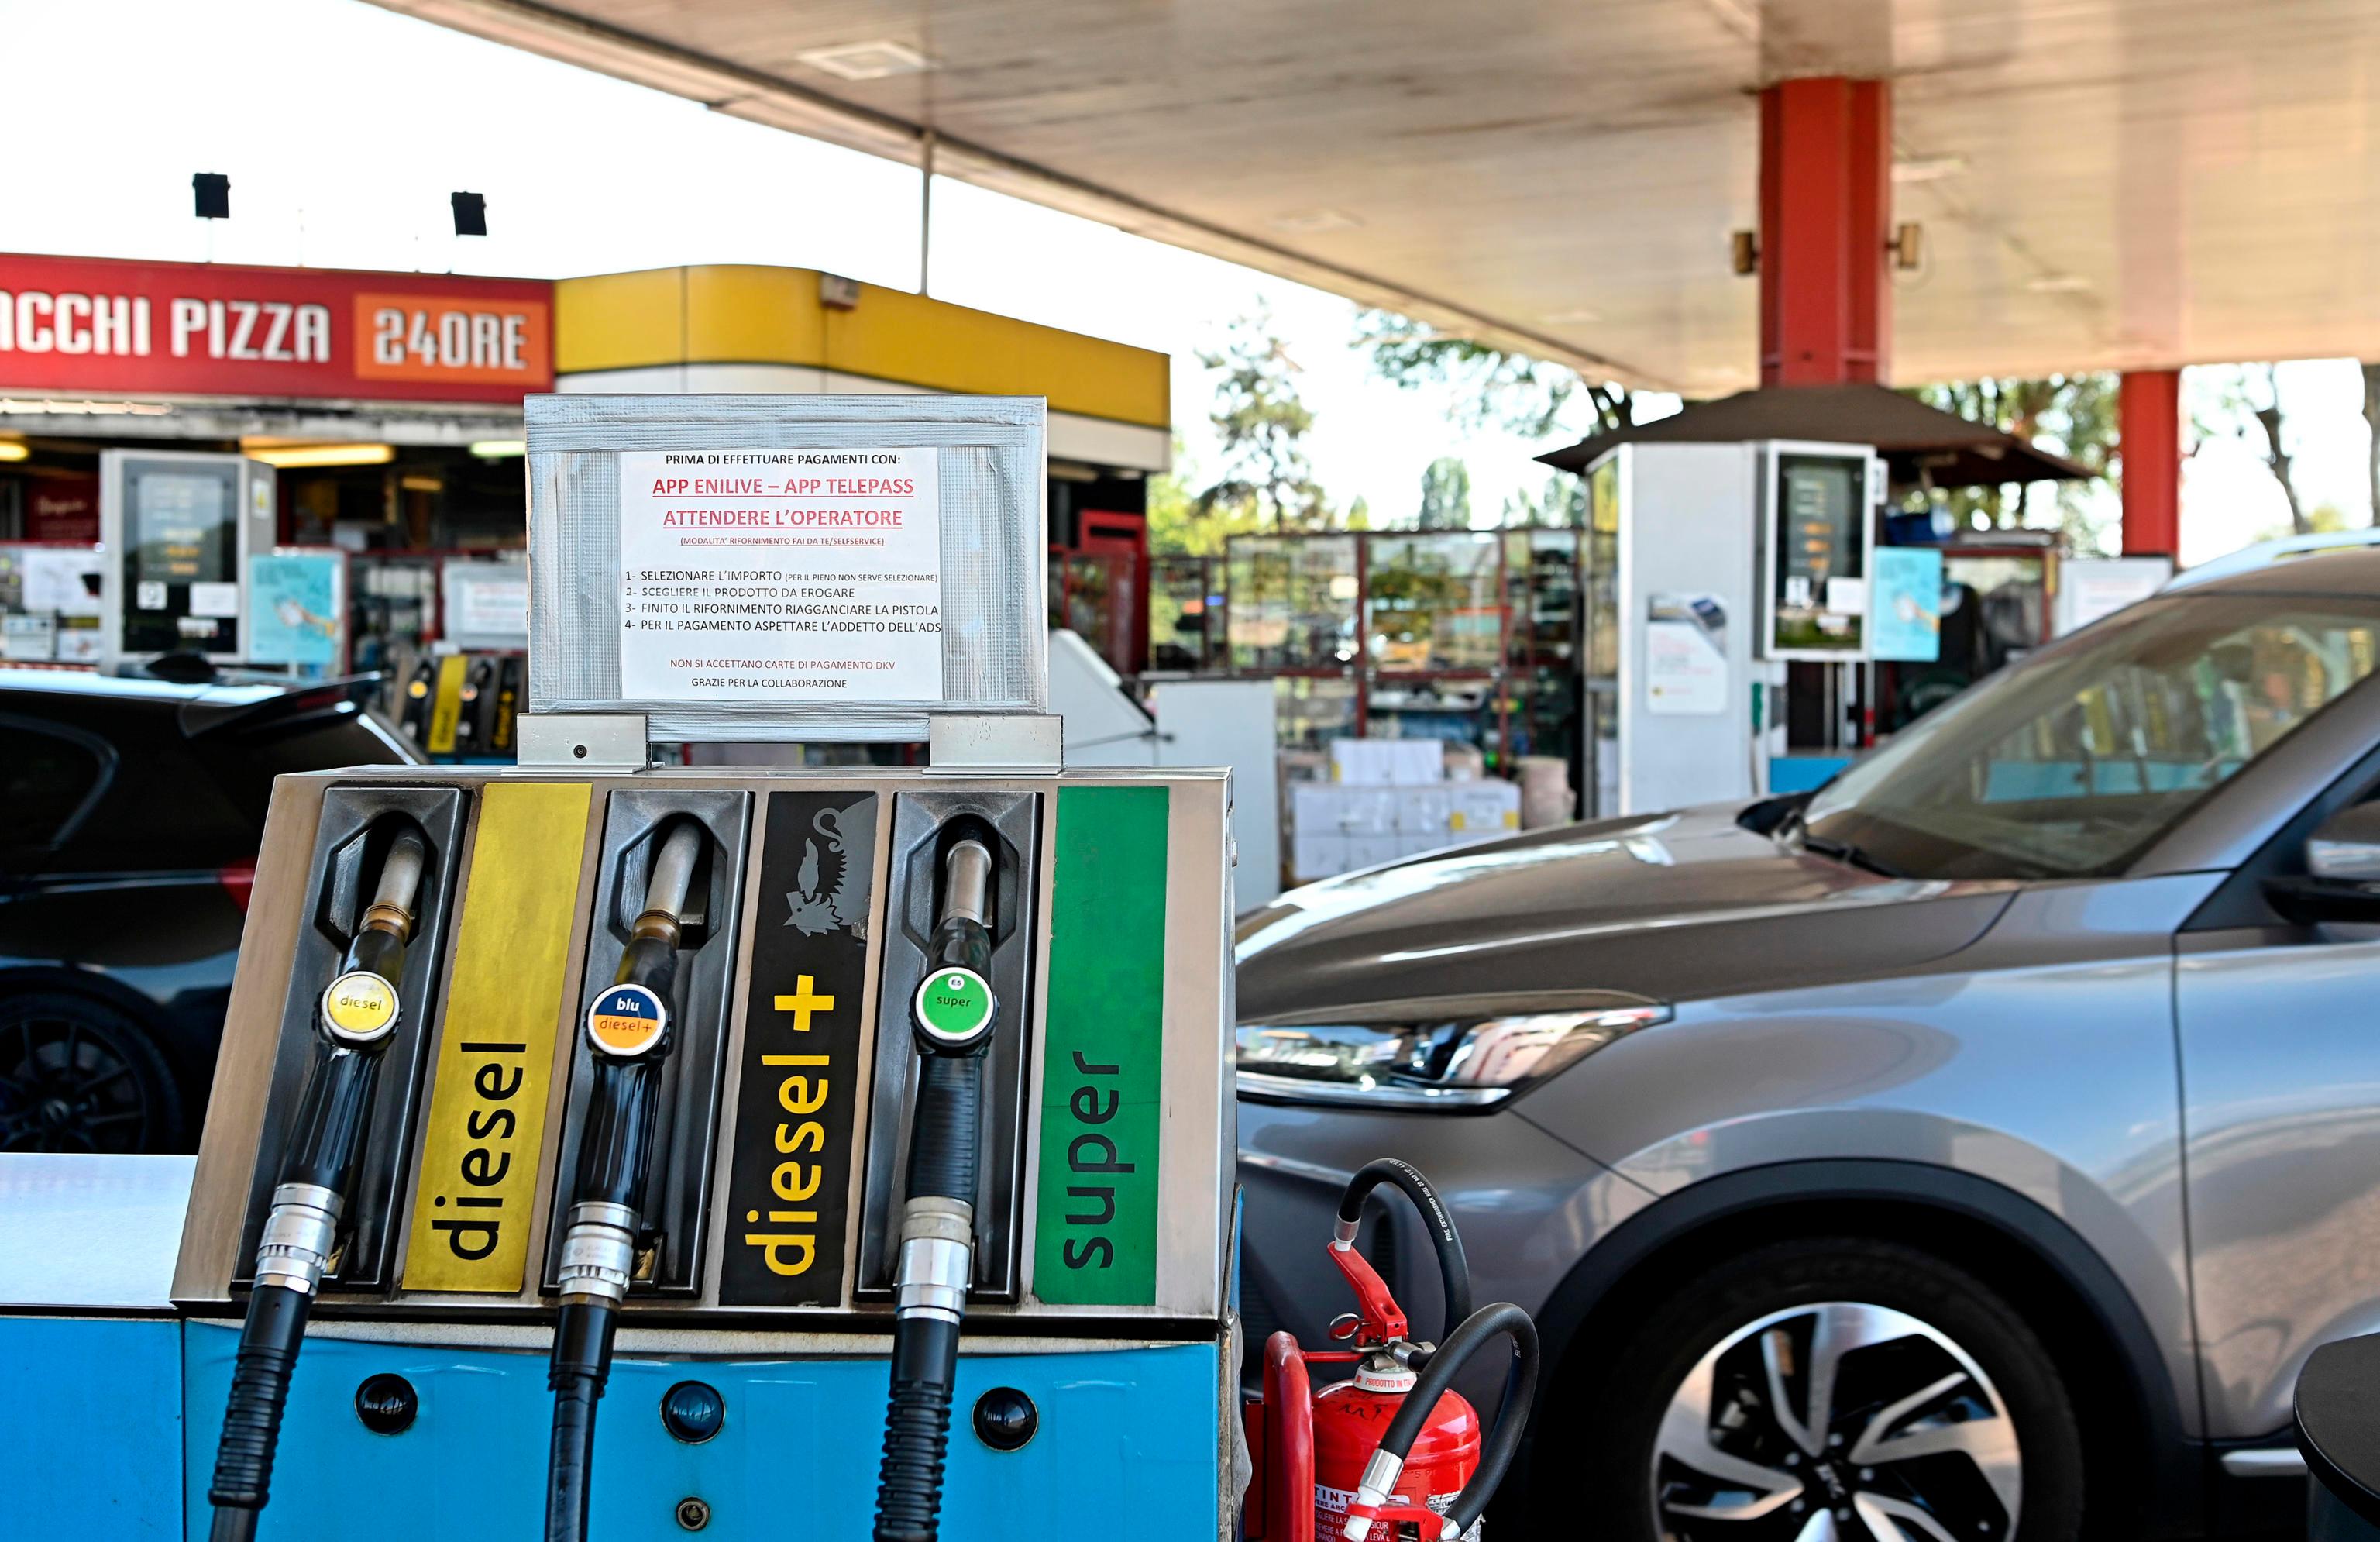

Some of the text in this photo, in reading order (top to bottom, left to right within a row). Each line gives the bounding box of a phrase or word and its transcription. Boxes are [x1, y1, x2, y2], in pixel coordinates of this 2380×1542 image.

[170, 298, 330, 363] PIZZA
[666, 454, 901, 465] PRIMA DI EFFETTUARE PAGAMENTI CON:
[652, 478, 690, 494] APP
[694, 478, 763, 494] ENILIVE
[783, 478, 821, 494] APP
[825, 478, 914, 494] TELEPASS
[662, 508, 903, 526] ATTENDERE L’OPERATORE
[679, 536, 729, 546] (MODALITA’
[792, 537, 805, 546] FAI
[807, 537, 819, 546] DA
[820, 537, 885, 547] TE/SELFSERVICE)
[625, 570, 637, 581] 1-
[639, 570, 715, 583] SELEZIONARE
[718, 570, 782, 582] L’IMPORTO
[785, 573, 803, 583] (PER
[812, 573, 837, 582] PIENO
[837, 573, 857, 582] NON
[858, 573, 882, 582] SERVE
[883, 573, 938, 583] SELEZIONARE)
[625, 587, 855, 598] 2- SCEGLIERE IL PRODOTTO DA EROGARE
[624, 602, 939, 616] 3- FINITO IL RIFORNIMENTO RIAGGANCIARE LA PISTOLA
[624, 619, 941, 633] 4- PER IL PAGAMENTO ASPETTARE L’ADDETTO DELL’ADS
[670, 659, 896, 670] NON SI ACCETTANO CARTE DI PAGAMENTO DKV
[691, 677, 848, 689] GRAZIE PER LA COLLABORAZIONE
[340, 995, 382, 1011] diesel
[616, 996, 640, 1012] blu
[937, 996, 972, 1008] super
[600, 1017, 652, 1033] diesel+
[432, 1042, 527, 1261] diesel
[1062, 1050, 1135, 1269] super
[1443, 1229, 1453, 1241] FIRE
[1365, 1377, 1395, 1388] PRODOTTO
[1330, 1503, 1345, 1512] ABC
